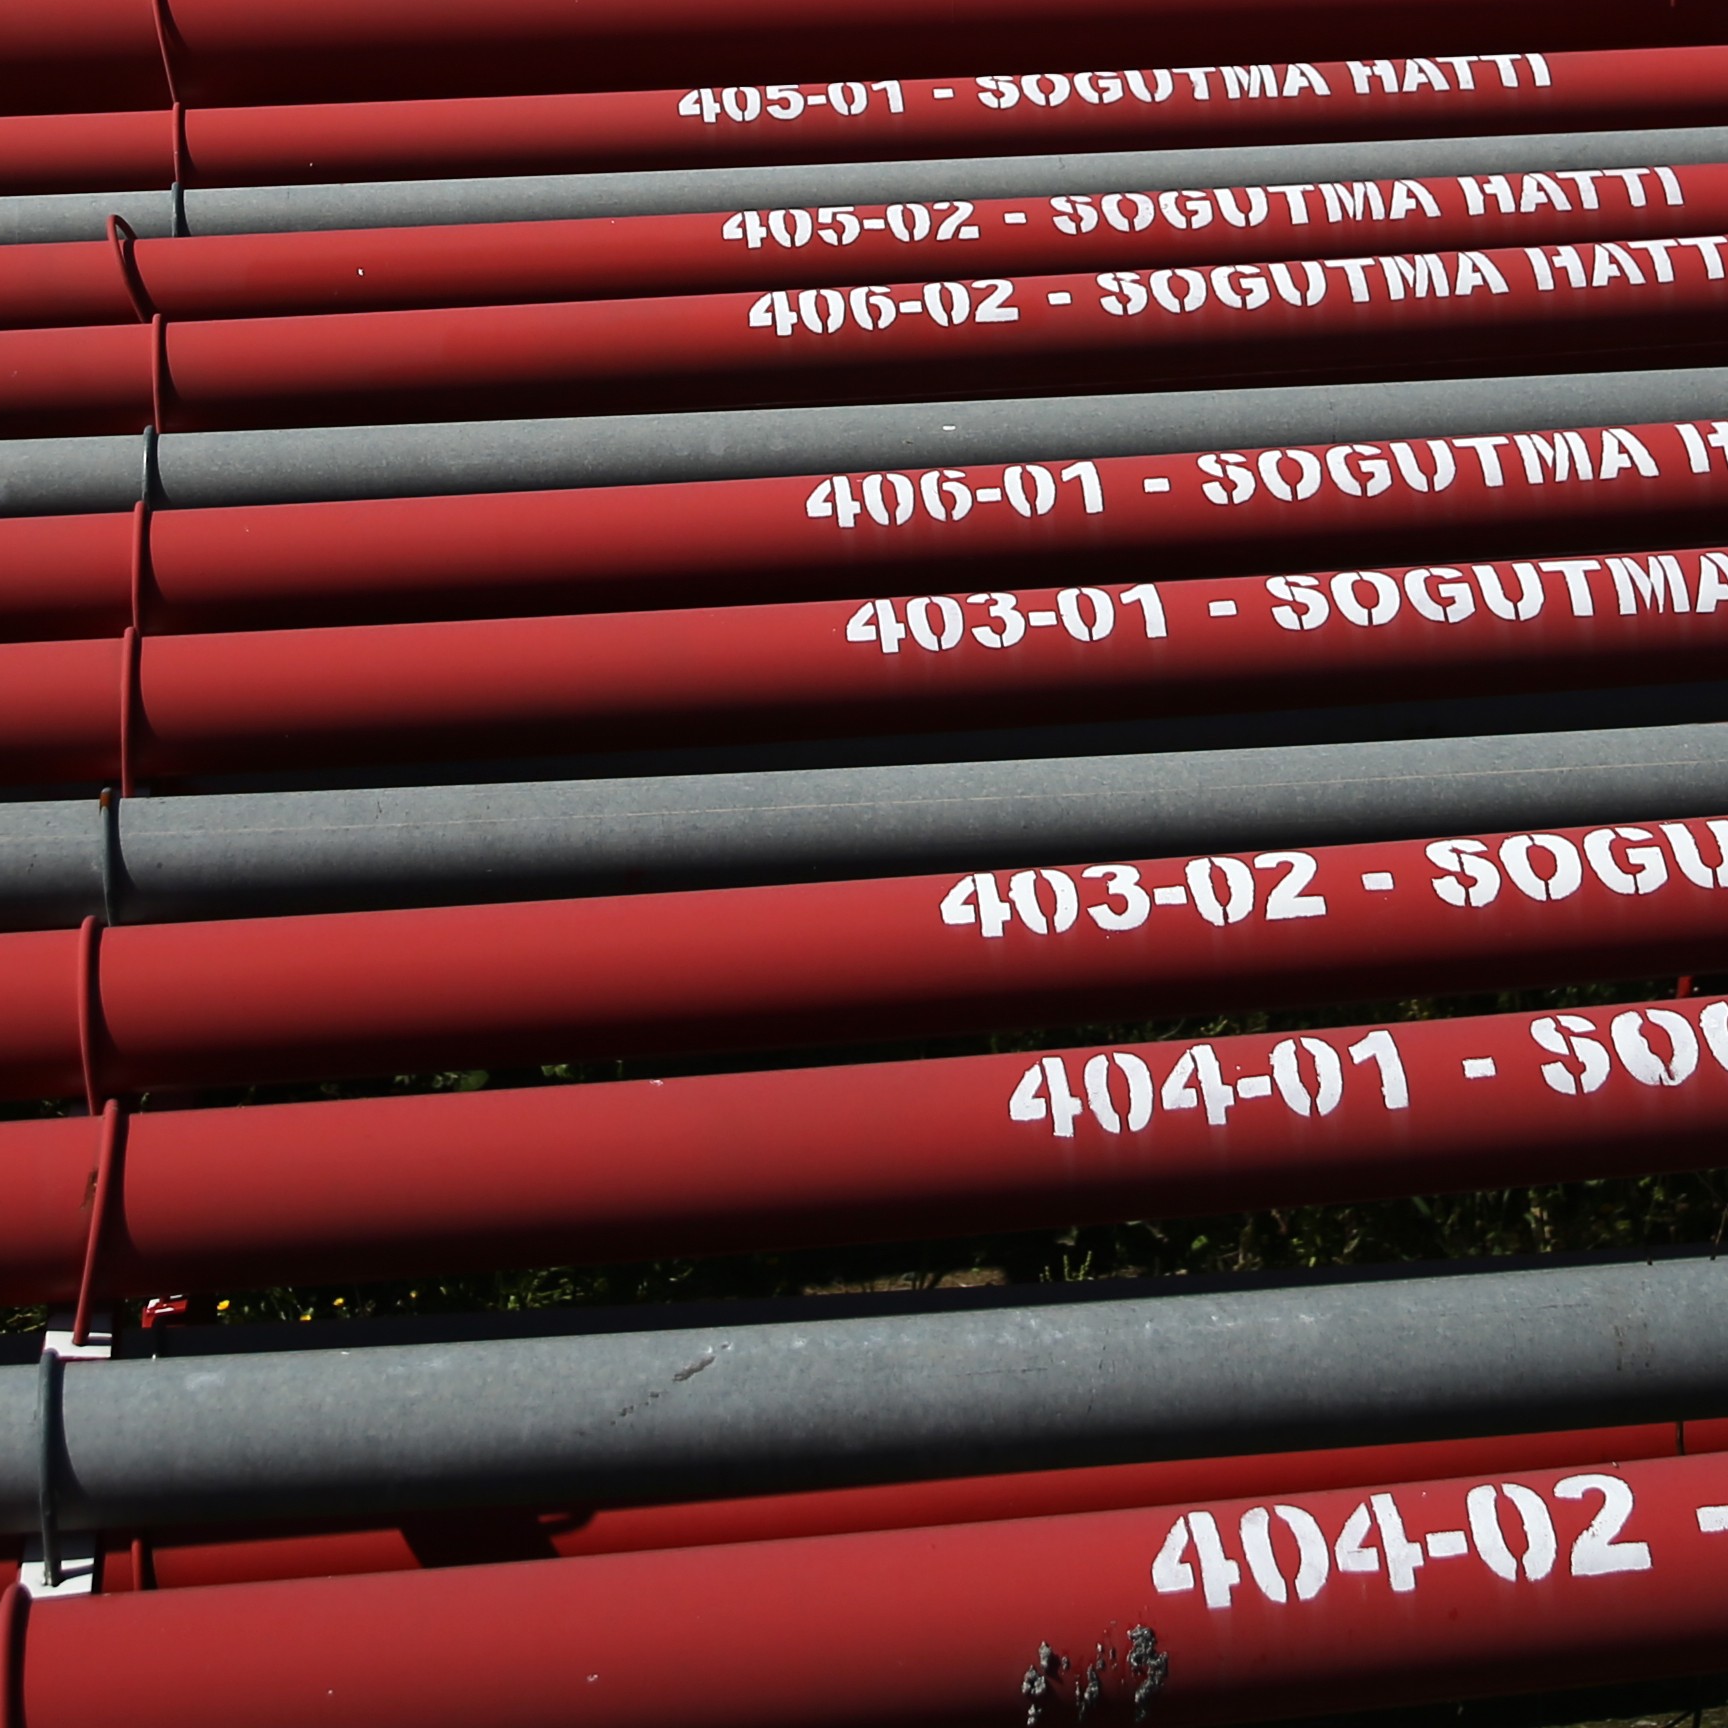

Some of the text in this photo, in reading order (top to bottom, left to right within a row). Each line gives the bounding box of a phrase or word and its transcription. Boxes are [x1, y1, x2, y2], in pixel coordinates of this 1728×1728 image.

[678, 79, 904, 123] 405-01
[975, 63, 1331, 109] SOGUTMA
[1345, 53, 1551, 94] HATTI
[722, 200, 980, 249] 405-02
[1050, 179, 1442, 235] SOGUTMA
[1456, 166, 1685, 218] HATTI
[748, 278, 1019, 336] 406-02
[1096, 251, 1509, 316] SOGUTMA
[806, 461, 1104, 528] 406-01
[1197, 428, 1659, 505] SOGUTMA
[846, 583, 1167, 654] 403-01
[940, 851, 1327, 938] 403-02
[1009, 1030, 1409, 1138] 404-01
[1151, 1474, 1652, 1609] 404-02
